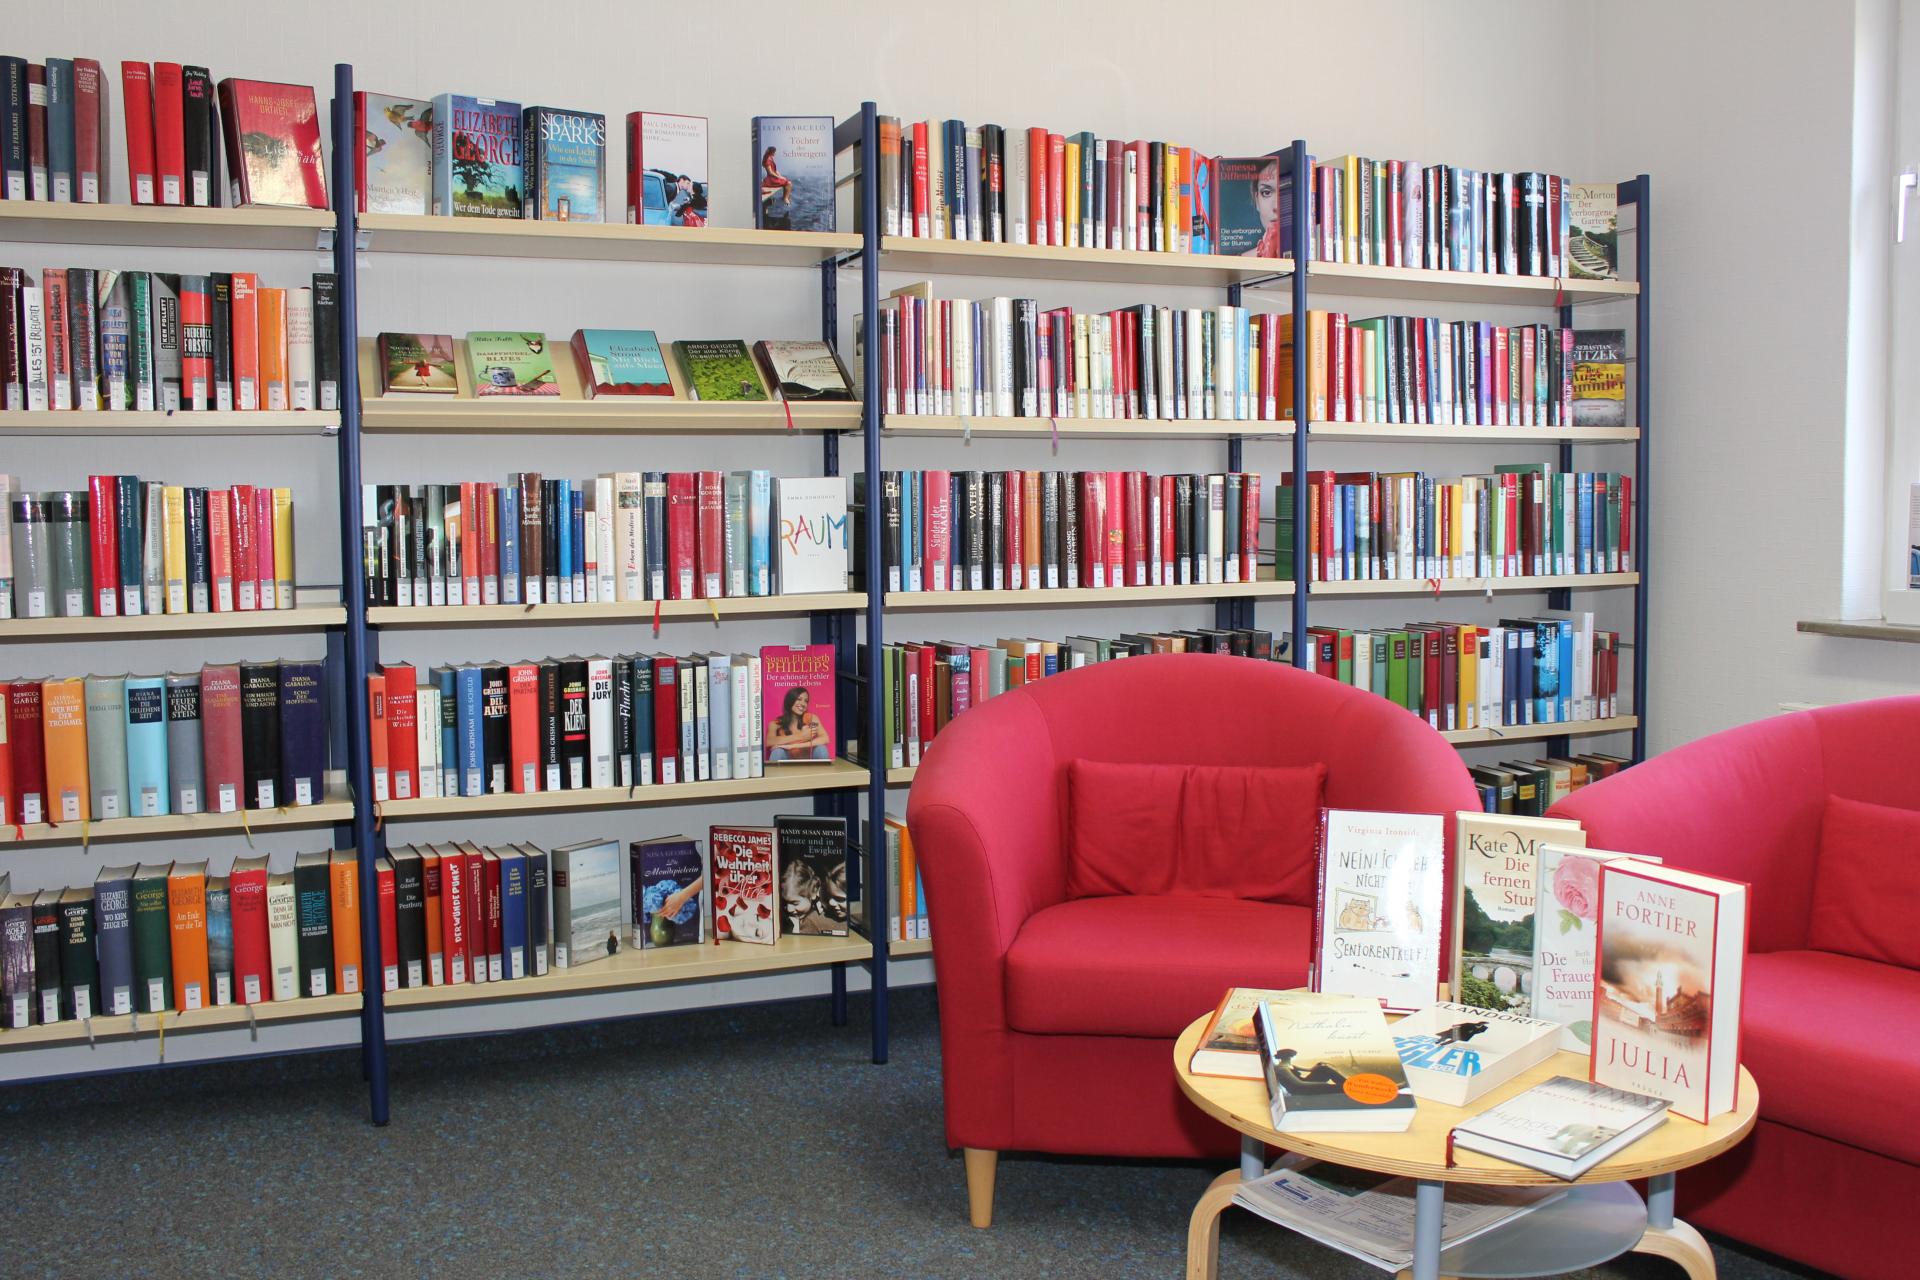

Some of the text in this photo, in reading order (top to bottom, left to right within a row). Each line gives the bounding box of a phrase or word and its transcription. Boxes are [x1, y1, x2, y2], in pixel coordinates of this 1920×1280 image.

[453, 109, 519, 138] ELIZABETH
[540, 112, 605, 133] NICHOLAS
[540, 124, 605, 147] SPARKS
[790, 135, 820, 145] Töchter
[452, 130, 521, 166] GEORGE
[549, 144, 562, 153] Wie
[576, 145, 596, 157] Licht
[782, 150, 828, 160] Schweigens
[1220, 163, 1257, 172] Vanessa
[1578, 187, 1616, 200] Morton
[453, 202, 520, 218] Wer dem Tode geweiht
[1570, 209, 1613, 218] verborgene
[1581, 217, 1608, 225] Garten
[102, 320, 129, 329] FOLLETT
[184, 327, 212, 339] FREDERICK
[184, 339, 212, 352] FORSYTH
[609, 344, 658, 352] Elizabeth
[969, 483, 977, 519] VATER
[939, 498, 948, 535] NACHT
[930, 506, 941, 548] Sünden der
[781, 512, 848, 556] RAUM
[765, 653, 830, 663] Susan Elizabeth
[767, 662, 829, 673] PHILLIPS
[489, 681, 503, 689] JOHN
[513, 675, 538, 683] GRISHAM
[483, 688, 508, 696] GRISHAM
[595, 682, 609, 691] DIE
[490, 697, 504, 706] DIE
[592, 690, 612, 700] JURY
[620, 680, 631, 719] Flucht
[171, 698, 197, 706] FEUER
[174, 704, 195, 712] UND
[570, 699, 583, 715] DER
[172, 710, 197, 719] STEIN
[483, 705, 508, 716] AKTE
[564, 711, 586, 732] KLIENT
[468, 718, 476, 749] GRISHAM
[469, 750, 477, 768] JOHN
[1347, 825, 1382, 837] Virginia
[713, 833, 772, 846] REBECCA JAMES
[782, 836, 834, 846] Heute und in
[1469, 833, 1508, 858] Kate
[733, 845, 753, 858] Die
[808, 845, 843, 856] Ewigkeit
[716, 856, 770, 872] Wahrheit
[1505, 857, 1530, 873] Die
[449, 863, 461, 894] PUNKT
[644, 867, 699, 878] Mondspielerin
[729, 870, 758, 885] über
[1483, 872, 1531, 889] fernen
[100, 890, 128, 900] ELIZABETH
[234, 885, 263, 894] George
[101, 899, 129, 911] GEORGE
[312, 889, 327, 926] GEORGE
[1637, 891, 1677, 911] ANNE
[65, 907, 89, 916] George
[103, 920, 129, 929] ZEUGE IST
[1616, 901, 1698, 938] FORTIER
[1541, 952, 1567, 967] Die
[1608, 1038, 1690, 1089] JULIA
